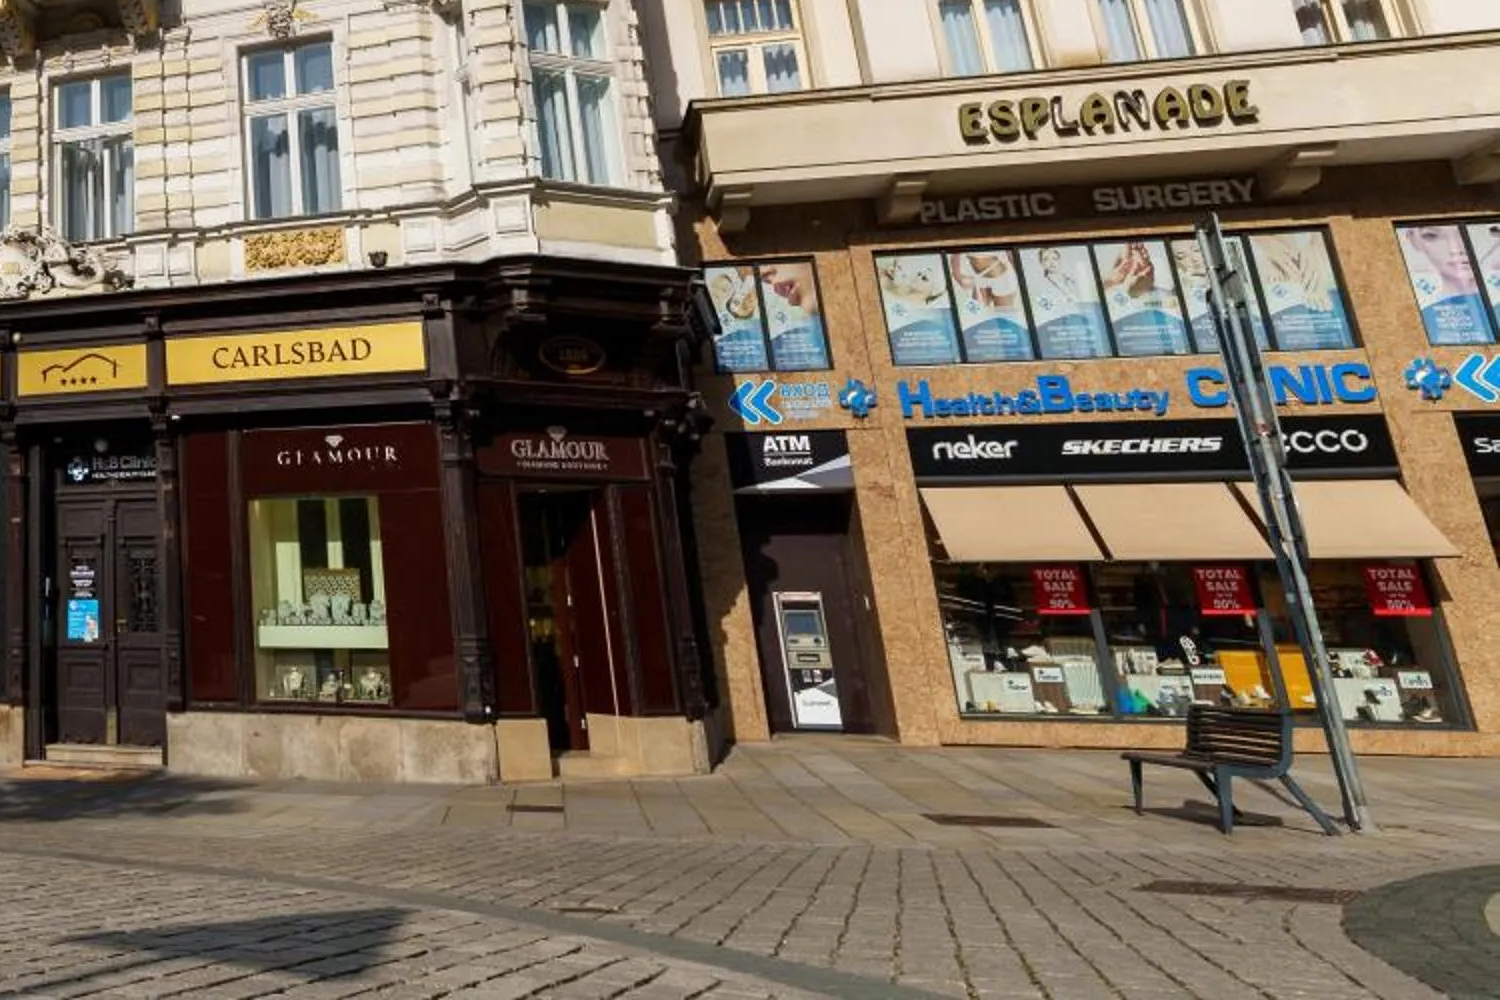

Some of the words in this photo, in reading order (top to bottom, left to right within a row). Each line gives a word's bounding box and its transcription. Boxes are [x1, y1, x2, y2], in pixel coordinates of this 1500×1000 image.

[958, 80, 1258, 145] ESPLANADE
[920, 192, 1056, 224] PLASTIC
[1092, 178, 1256, 212] SURGERY
[212, 338, 372, 369] CARLSBAD
[1186, 363, 1377, 407] CNIC
[511, 440, 610, 461] GLAMOUR
[763, 435, 811, 451] ATM
[1061, 437, 1223, 456] SKECHERS
[276, 446, 398, 465] GLAMOUR
[1033, 569, 1076, 580] TOTAL
[1195, 568, 1244, 580] TOTAL
[1367, 568, 1416, 580] TOTAL
[1043, 581, 1075, 592] SALE
[1205, 581, 1239, 592] SALE
[1377, 581, 1413, 592] SALE
